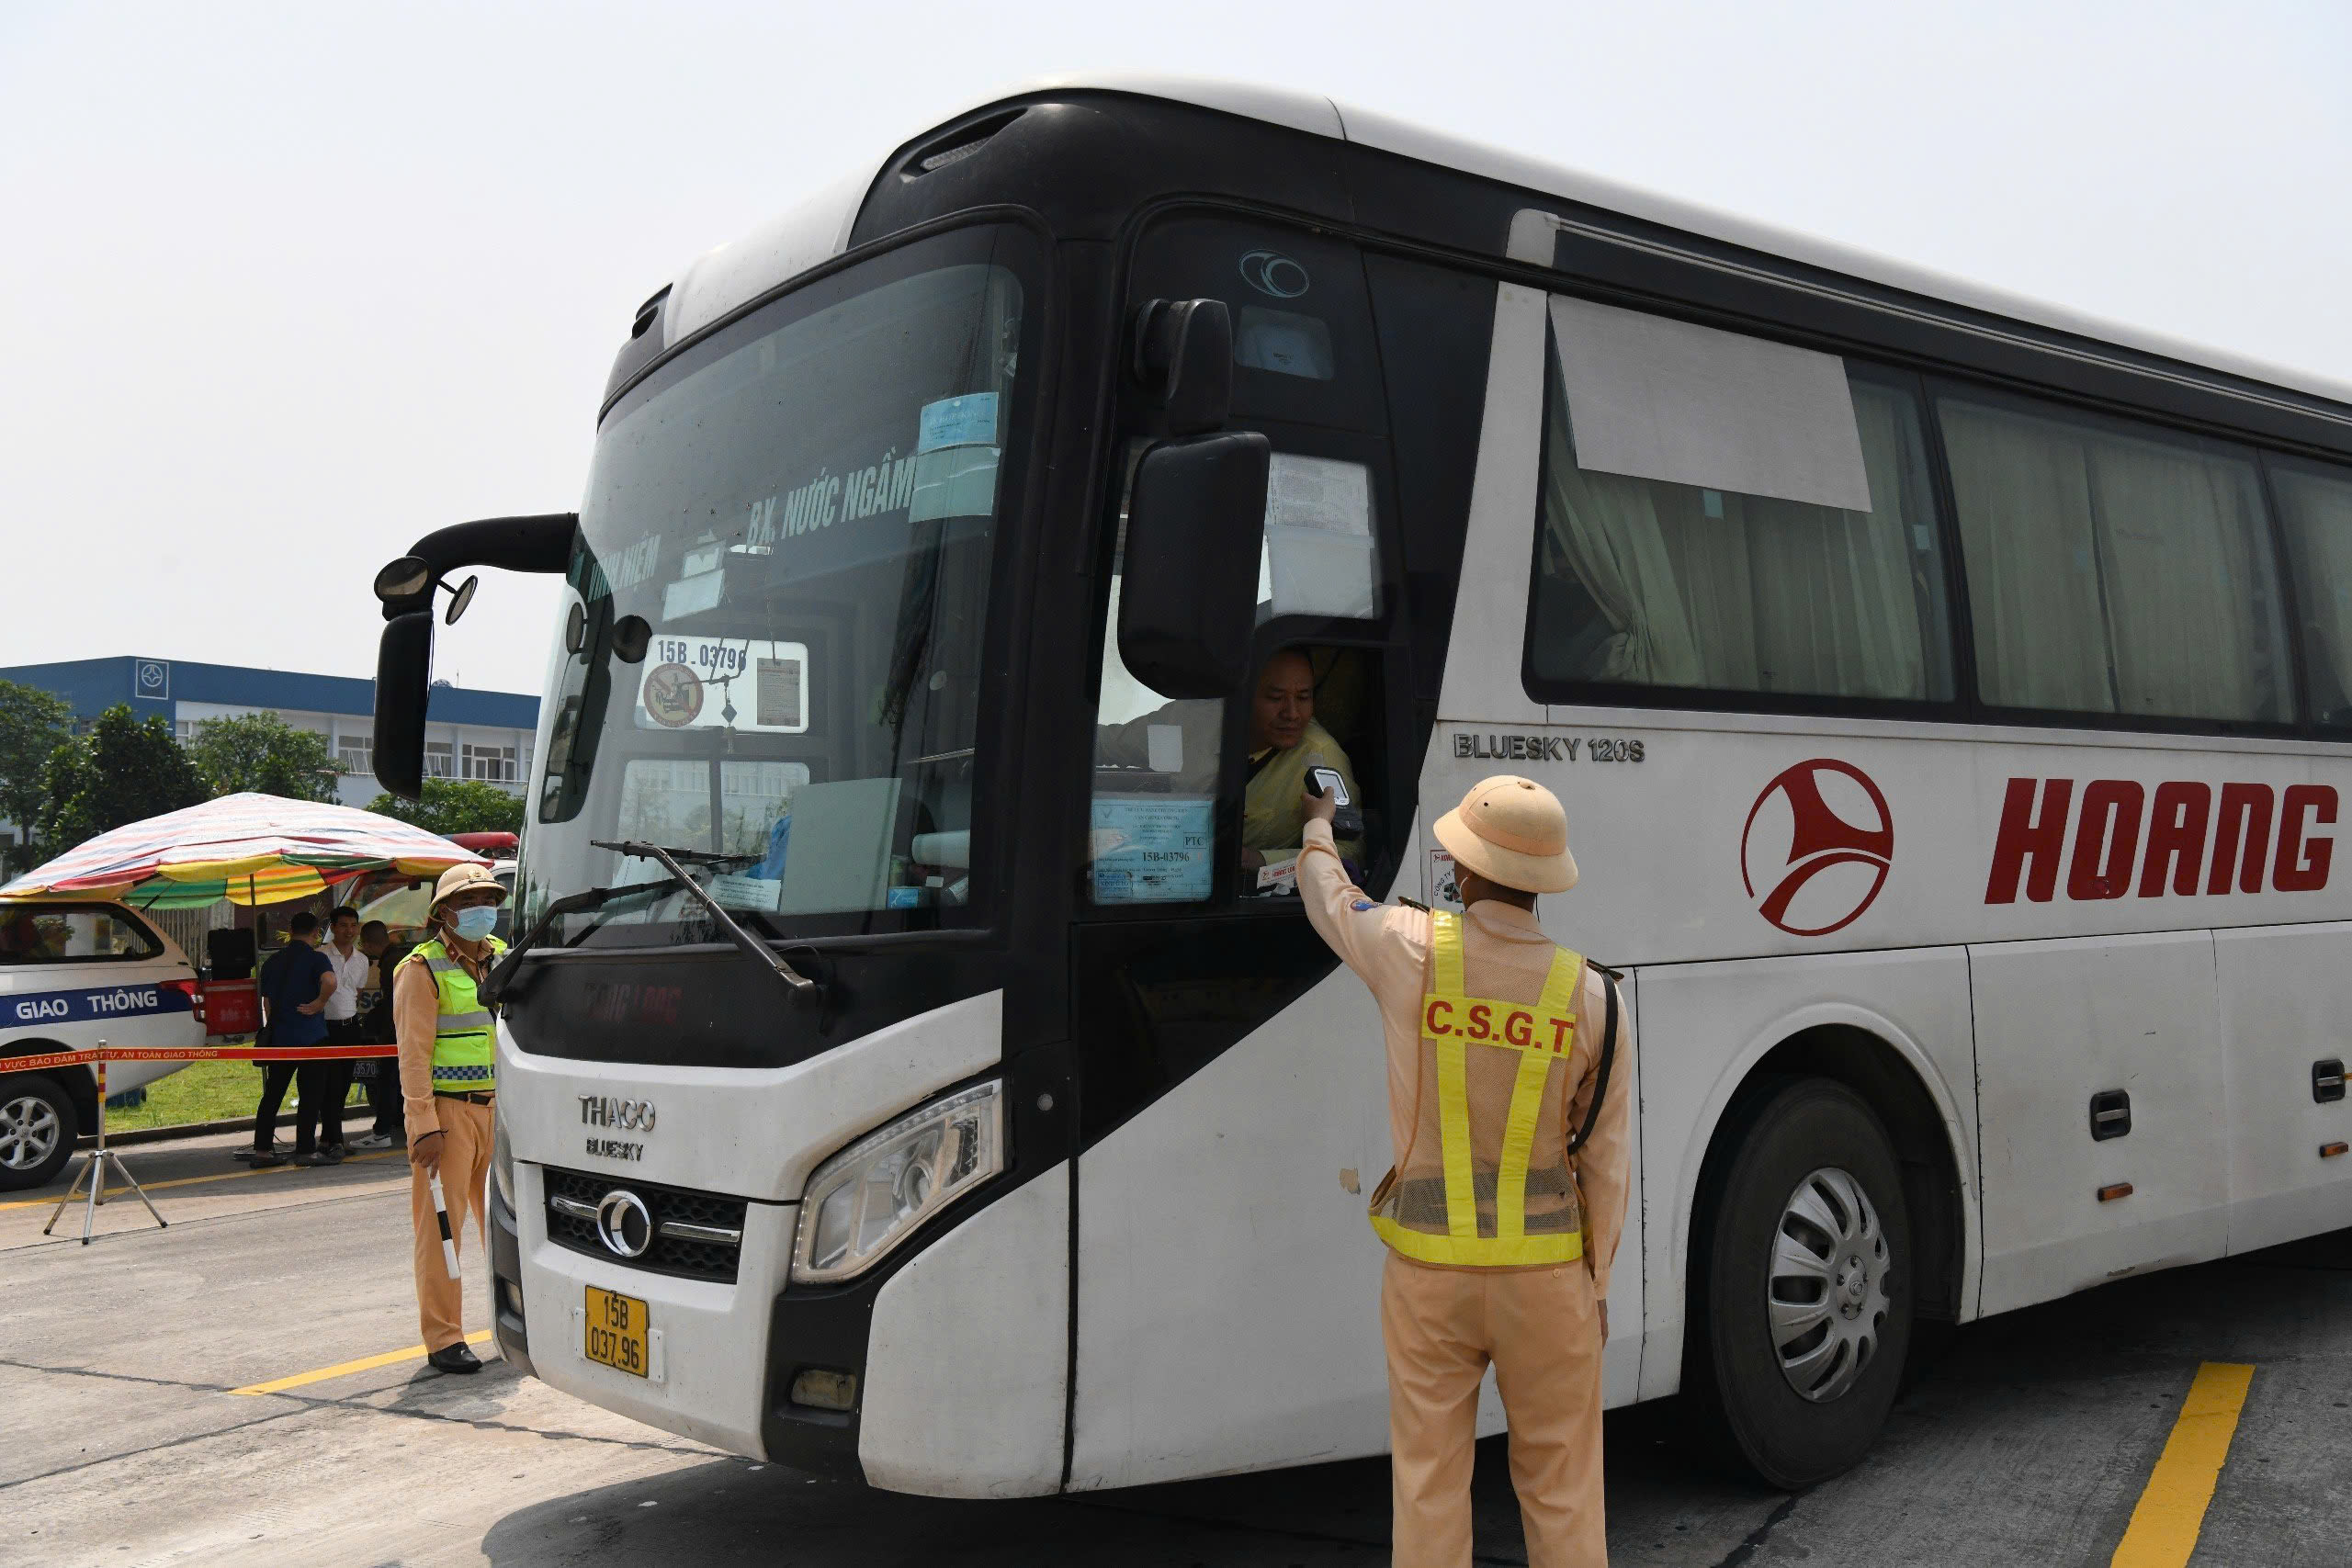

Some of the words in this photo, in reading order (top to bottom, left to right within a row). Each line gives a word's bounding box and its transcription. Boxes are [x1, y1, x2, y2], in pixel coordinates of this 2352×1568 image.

[781, 467, 840, 540] NƯỚC
[841, 446, 918, 523] NGẦM
[1453, 734, 1581, 761] BLUESKY
[1588, 738, 1645, 762] 120S
[1185, 836, 1204, 846] PTC
[1984, 777, 2339, 905] HOANG
[16, 998, 69, 1020] GIAO
[87, 989, 158, 1013] THÔNG
[1427, 1000, 1575, 1054] C.S.G.T
[137, 1050, 161, 1059] TOÀN
[163, 1051, 186, 1059] GIAO
[187, 1050, 218, 1058] THÔNG
[578, 1095, 656, 1133] THACO
[586, 1138, 644, 1162] BLUESKY
[605, 1295, 628, 1330] 15B
[591, 1326, 639, 1370] 037.96
